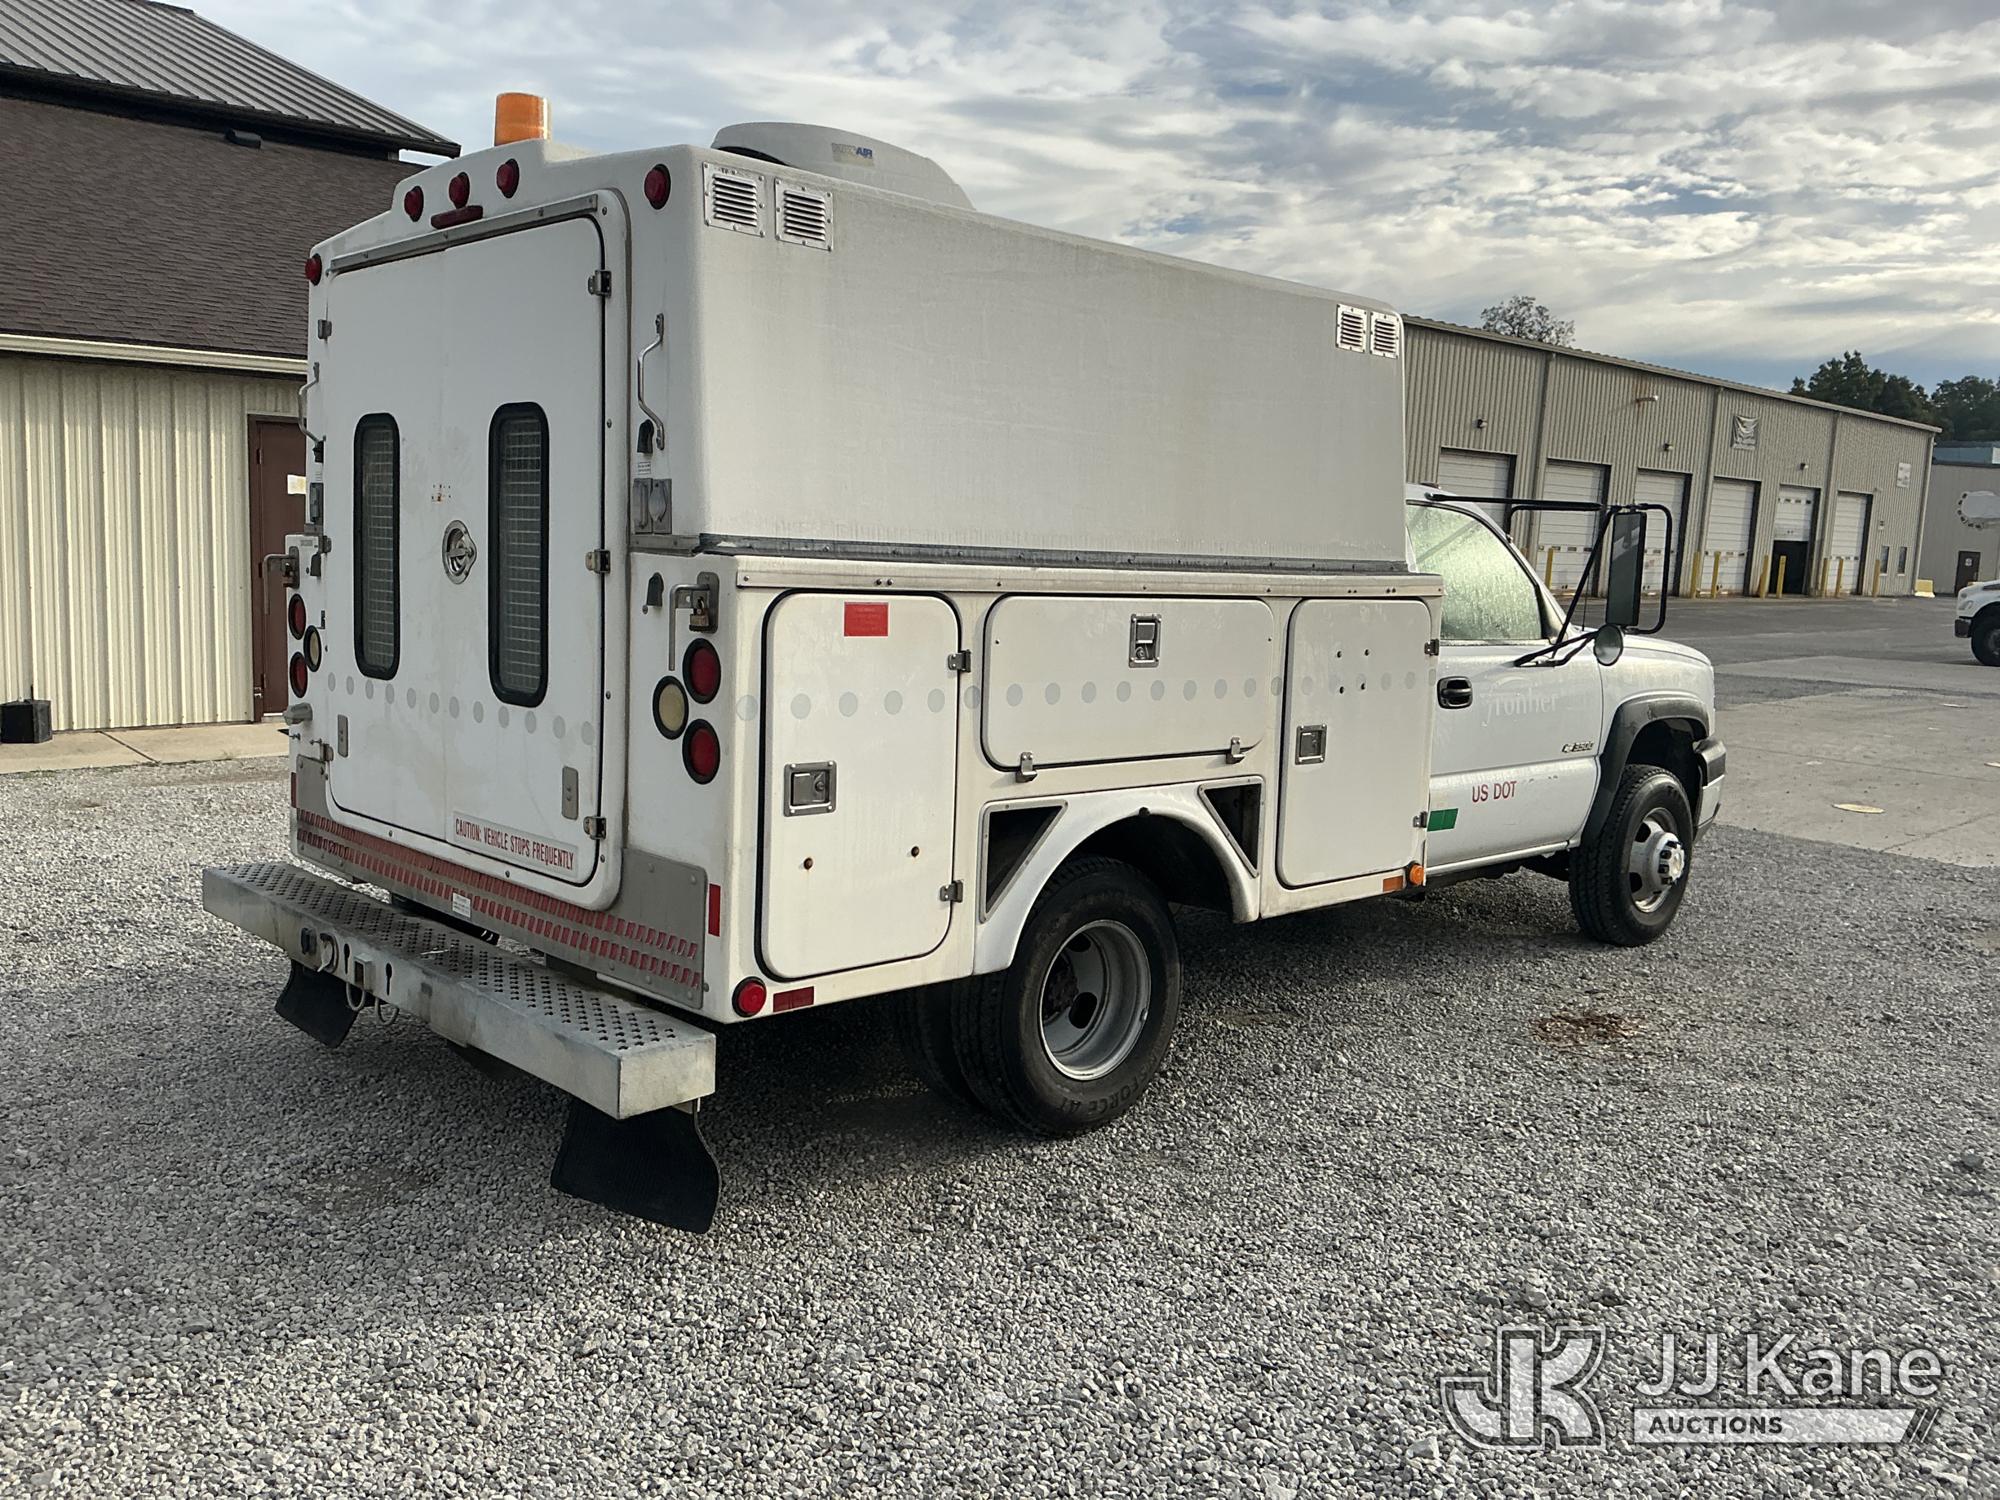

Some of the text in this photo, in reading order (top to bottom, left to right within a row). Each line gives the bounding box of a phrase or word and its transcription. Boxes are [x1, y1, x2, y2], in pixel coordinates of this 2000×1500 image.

[1472, 780, 1517, 803] US DOT
[455, 818, 574, 870] CAUTION: VEHICLE STOPS FREQUENTLY
